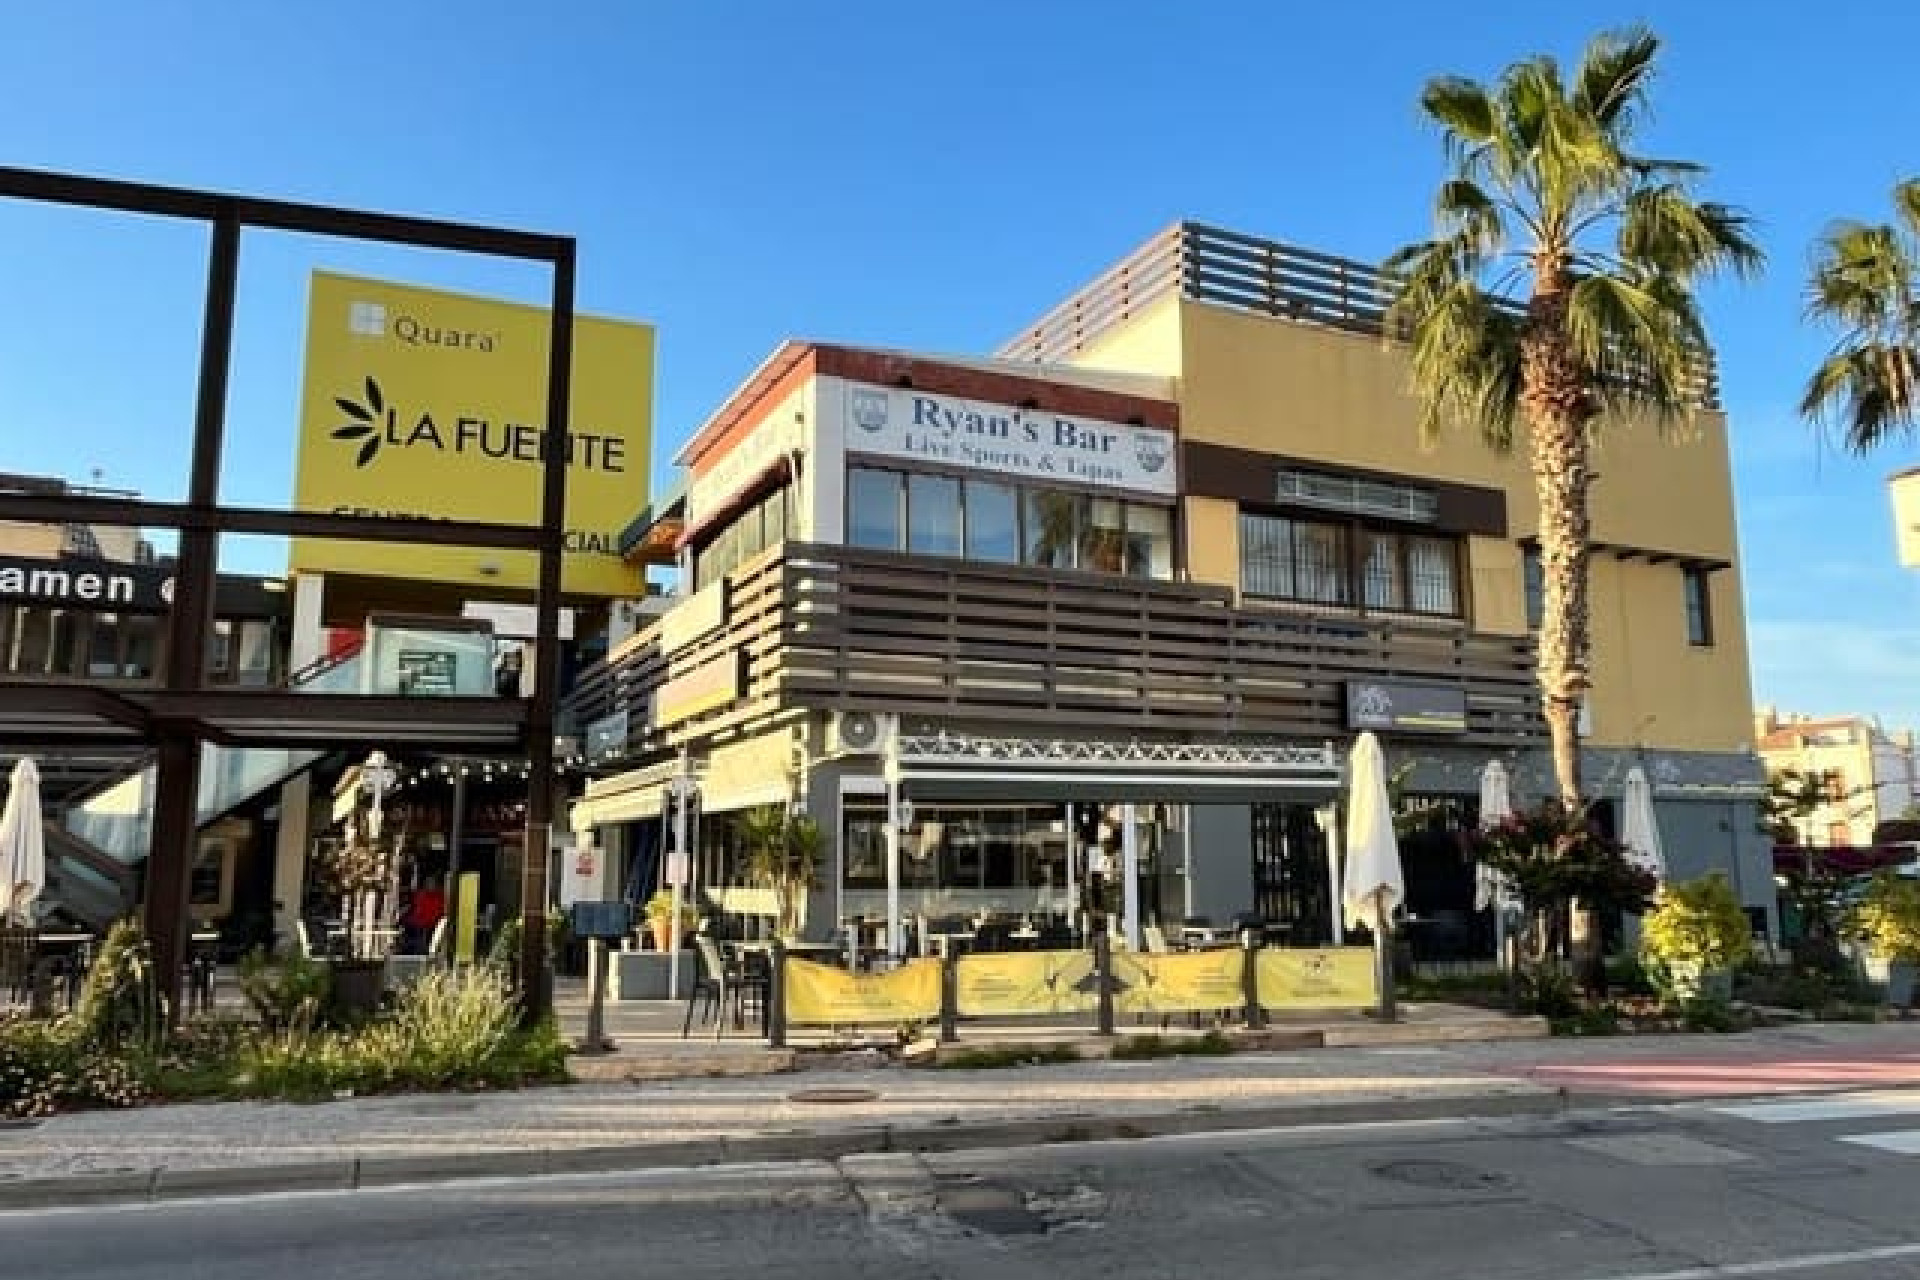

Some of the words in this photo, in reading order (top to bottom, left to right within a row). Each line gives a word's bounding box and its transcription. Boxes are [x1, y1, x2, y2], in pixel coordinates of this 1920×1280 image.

[386, 408, 444, 449] LA
[911, 397, 1039, 440] Ryan's
[1055, 418, 1117, 453] Bar
[905, 432, 950, 458] Live
[960, 441, 1030, 467] Sports
[1038, 451, 1055, 472] &
